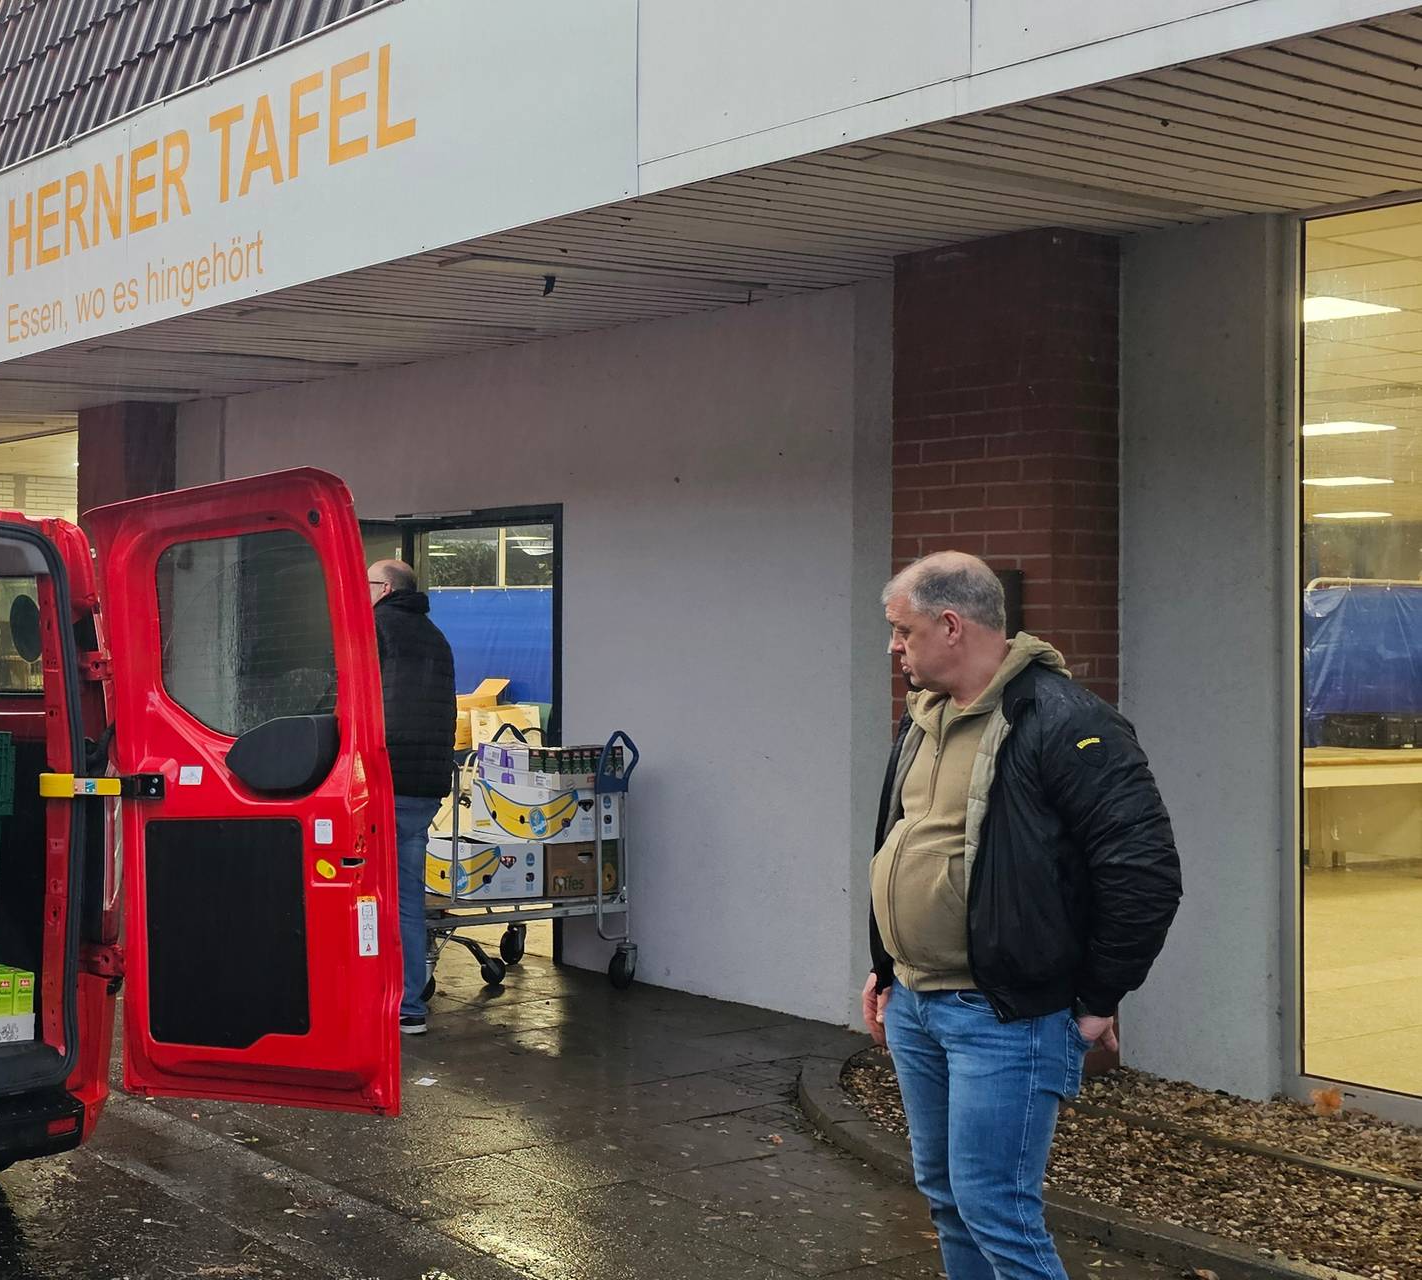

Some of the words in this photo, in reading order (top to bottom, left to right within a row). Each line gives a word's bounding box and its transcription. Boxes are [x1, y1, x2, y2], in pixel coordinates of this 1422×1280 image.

[7, 129, 191, 276] HERNER
[209, 43, 416, 203] TAFEL
[7, 302, 68, 344] Essen,
[75, 287, 106, 324] wo
[113, 275, 139, 314] es
[146, 230, 264, 307] hingehört
